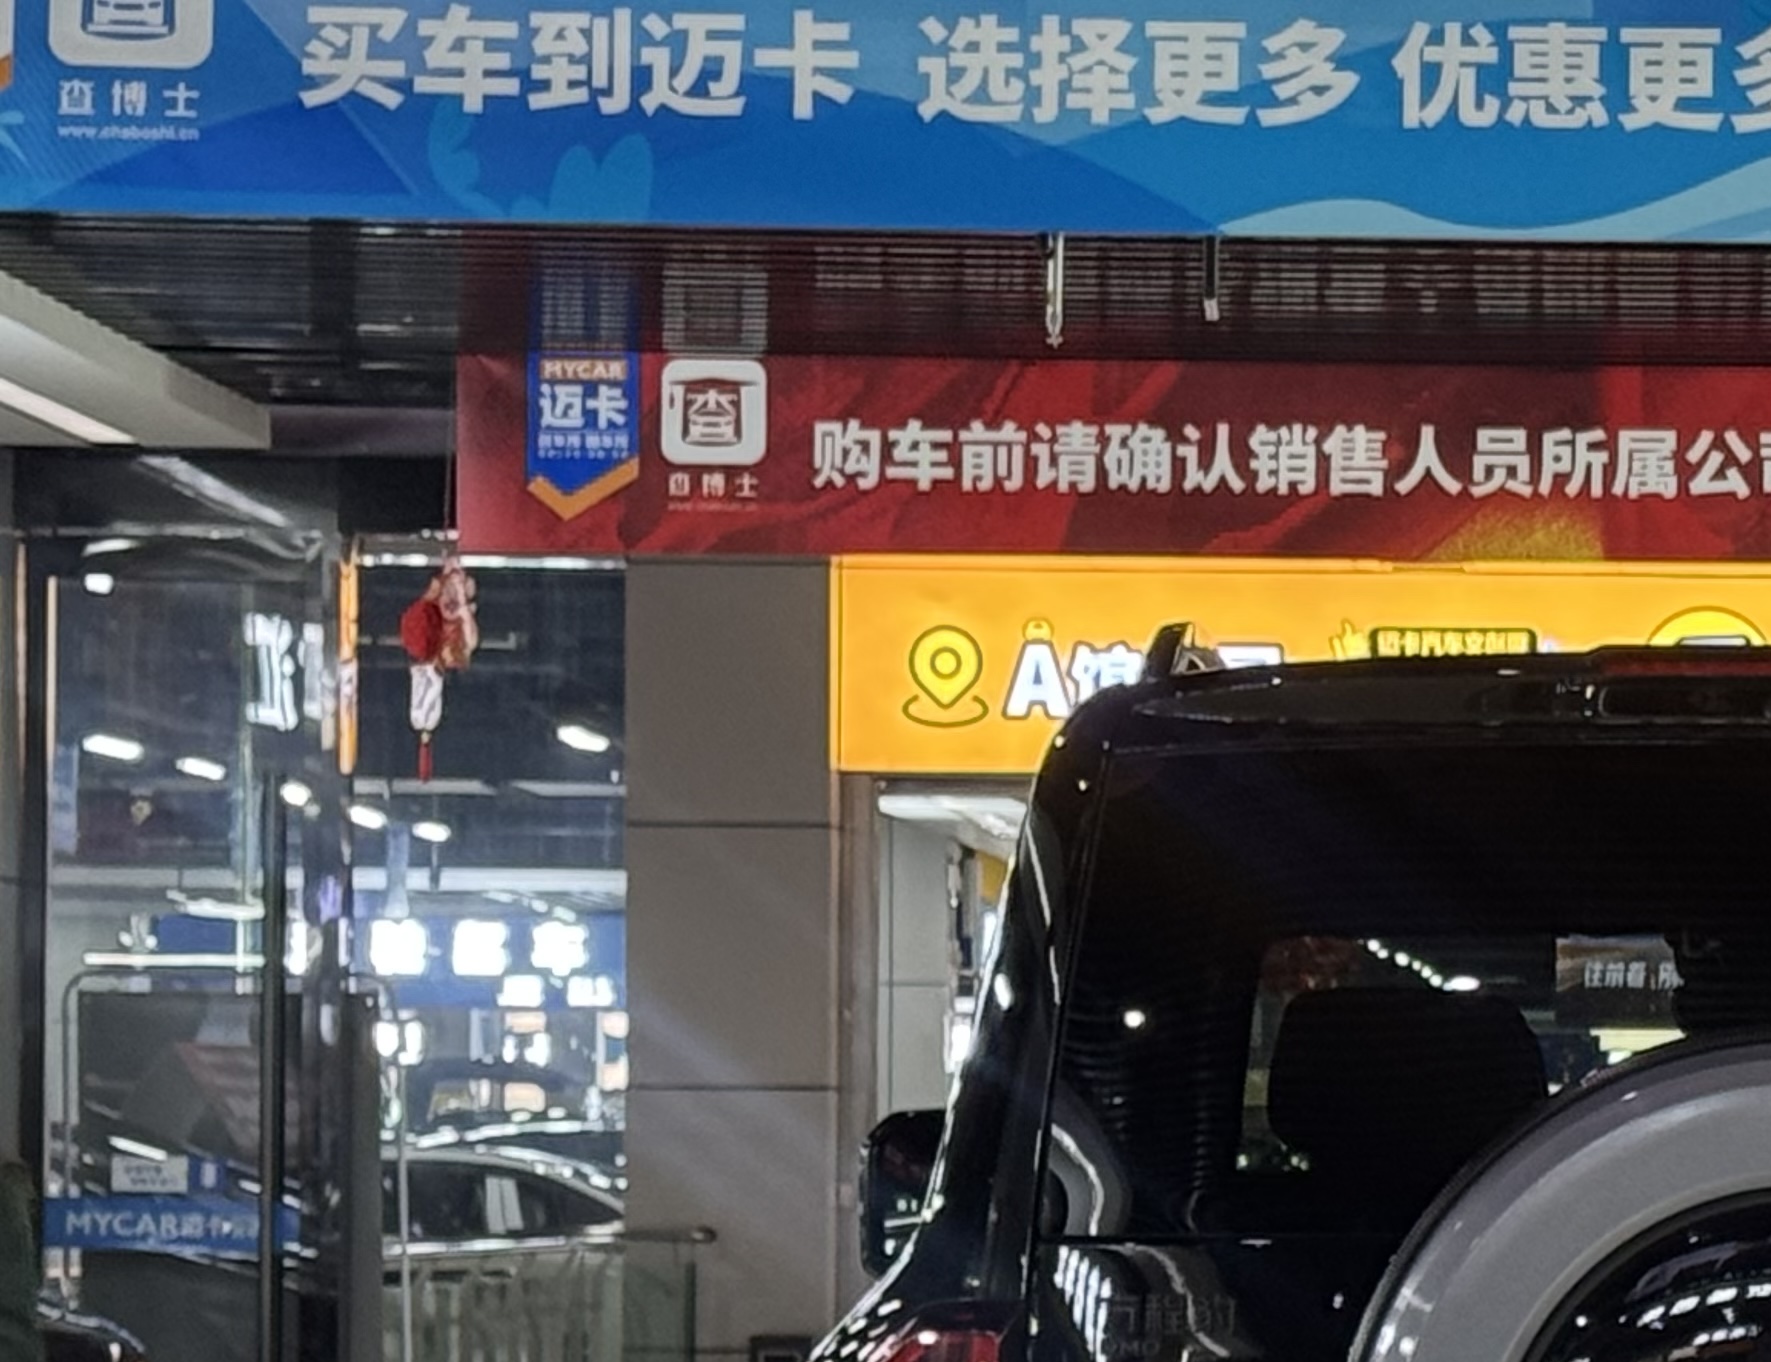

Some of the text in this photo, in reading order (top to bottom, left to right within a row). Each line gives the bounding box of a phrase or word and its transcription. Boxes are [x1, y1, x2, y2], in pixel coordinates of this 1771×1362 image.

[299, 4, 861, 121] 买车到迈卡
[916, 16, 1360, 128] 选择更多
[57, 78, 201, 119] 查博士
[542, 360, 625, 379] MYCAR
[538, 383, 629, 430] 迈卡
